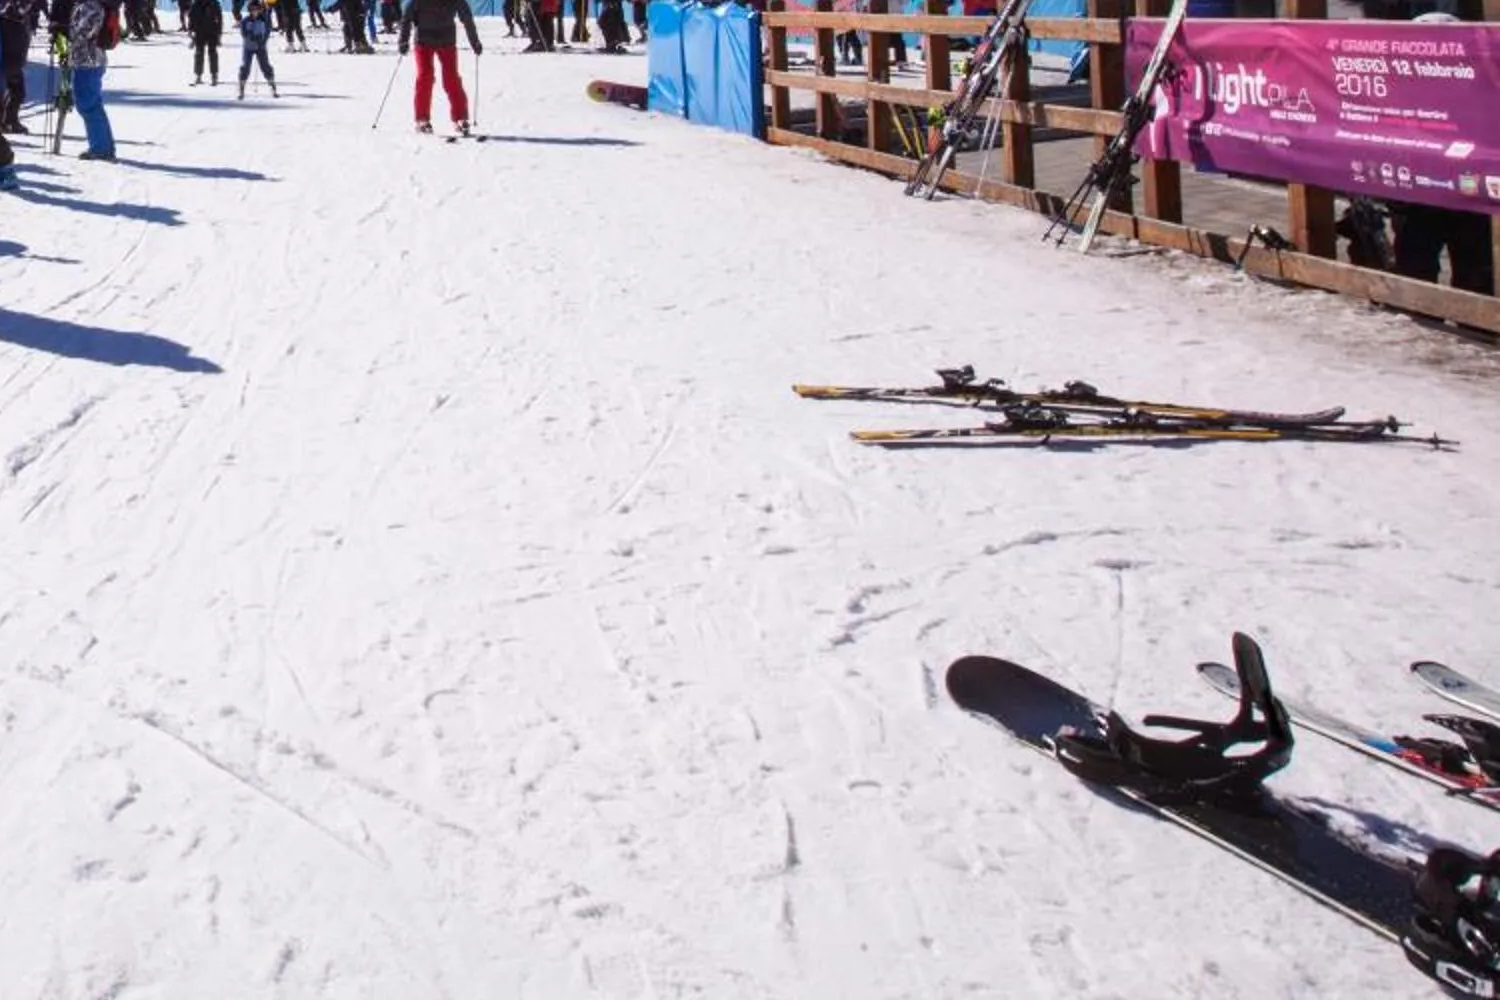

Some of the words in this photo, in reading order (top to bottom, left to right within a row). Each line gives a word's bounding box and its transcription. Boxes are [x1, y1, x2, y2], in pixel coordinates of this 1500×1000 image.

[1341, 39, 1389, 55] GRANDE
[1391, 41, 1466, 57] FIACCOLATA
[1391, 59, 1413, 76] 12
[1334, 73, 1388, 98] 2016
